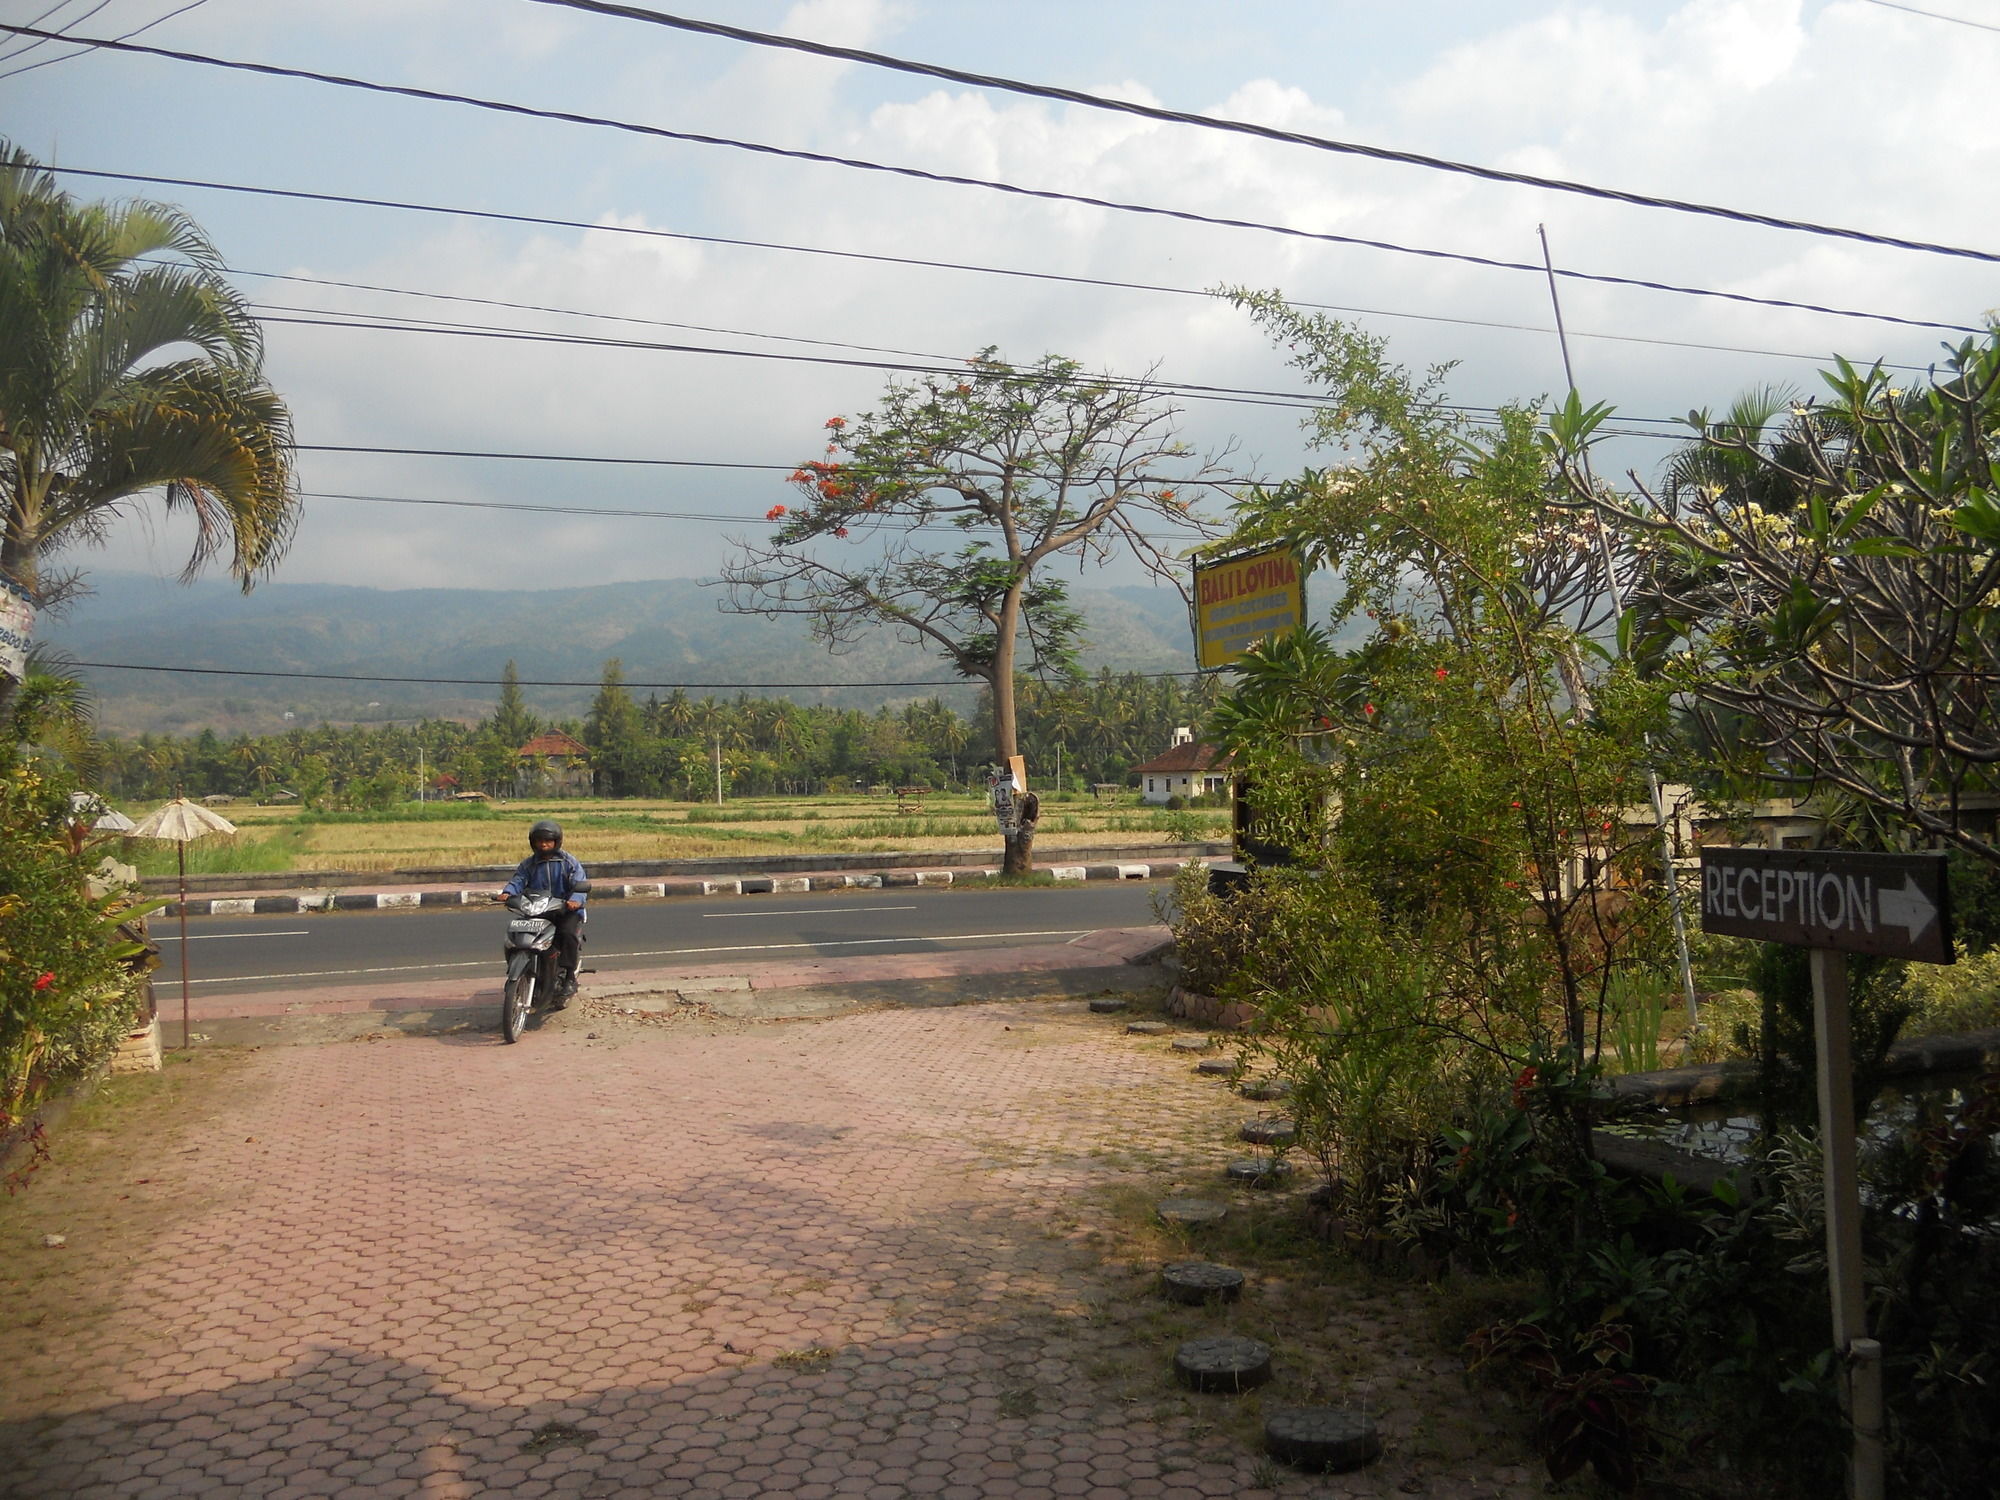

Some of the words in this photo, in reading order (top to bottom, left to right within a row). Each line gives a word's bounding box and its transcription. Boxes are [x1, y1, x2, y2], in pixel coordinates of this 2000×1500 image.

[1201, 570, 1234, 605] BALI
[1237, 557, 1297, 596] LOVINA
[1705, 865, 1873, 934] RECEPTION
